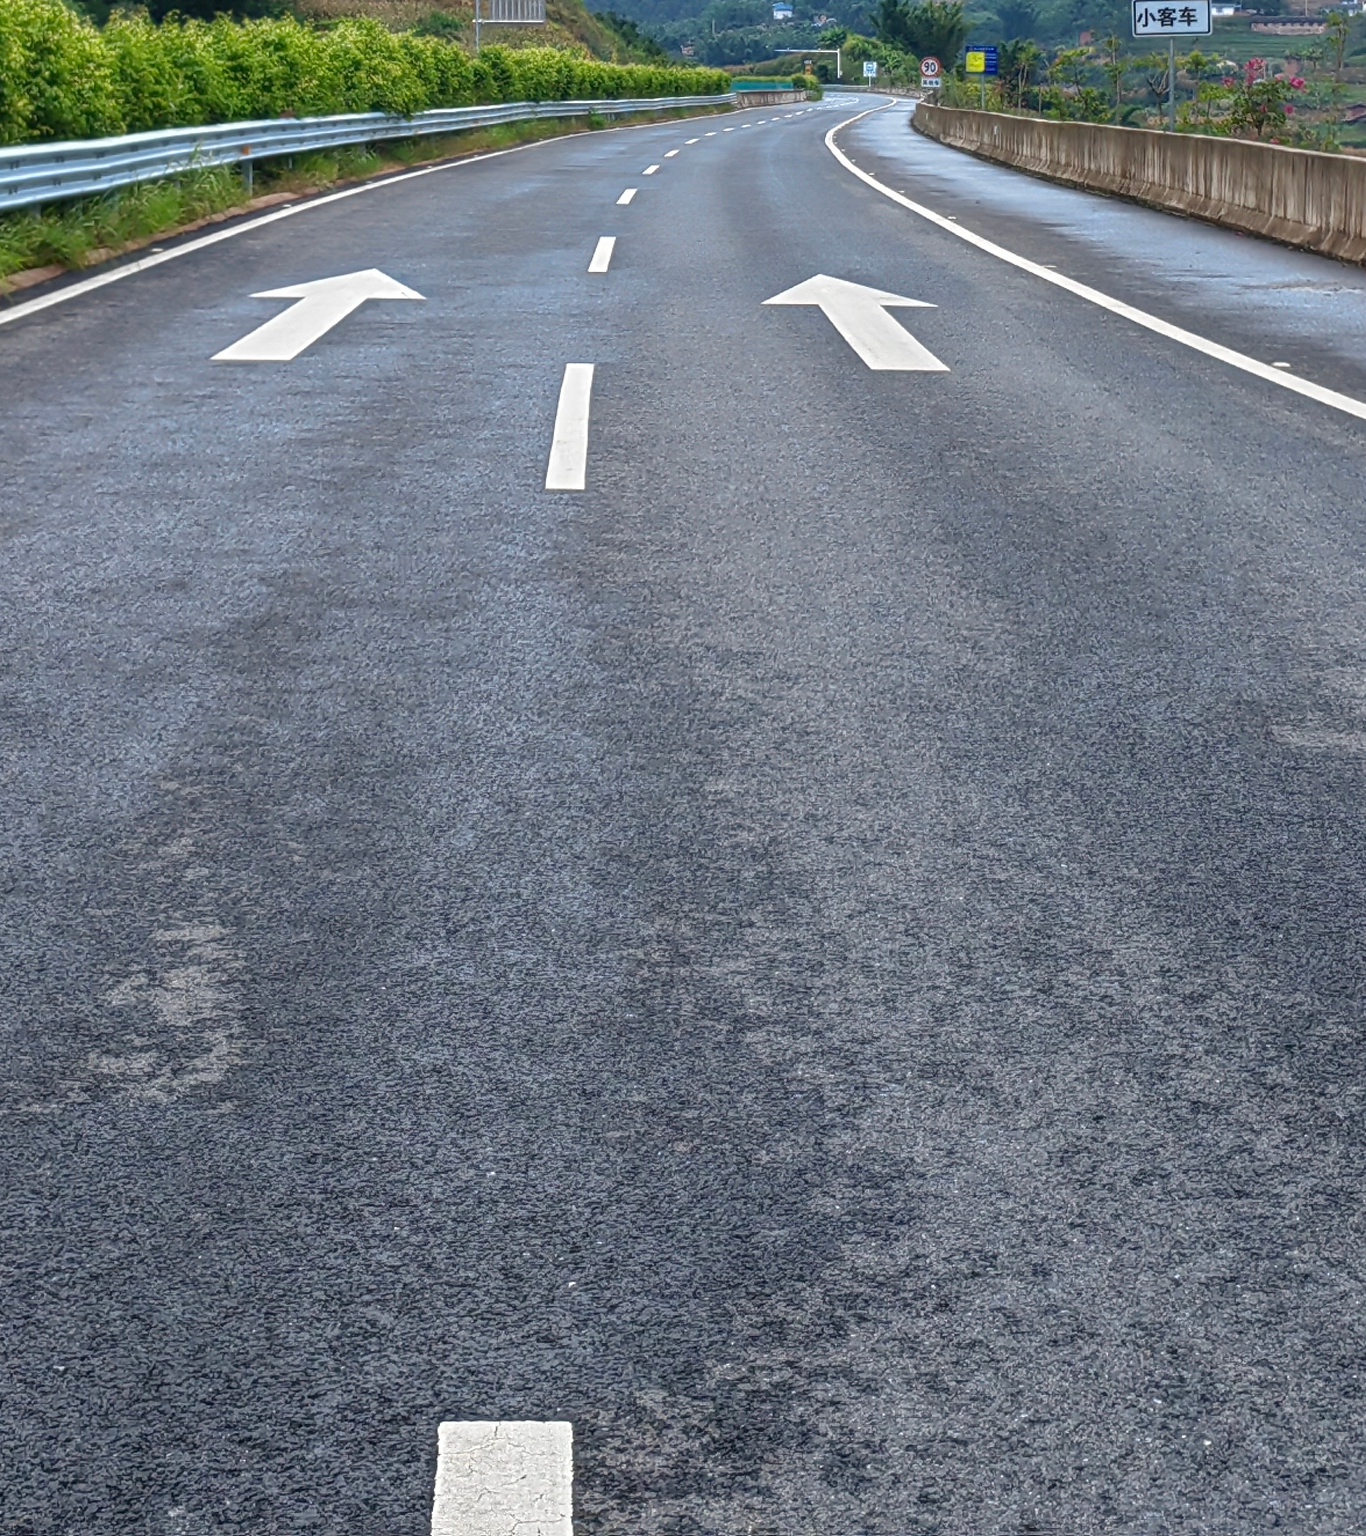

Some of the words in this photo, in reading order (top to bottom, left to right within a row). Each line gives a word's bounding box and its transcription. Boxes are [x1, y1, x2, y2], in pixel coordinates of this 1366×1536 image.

[1137, 7, 1198, 28] 小客车
[924, 61, 937, 73] 90
